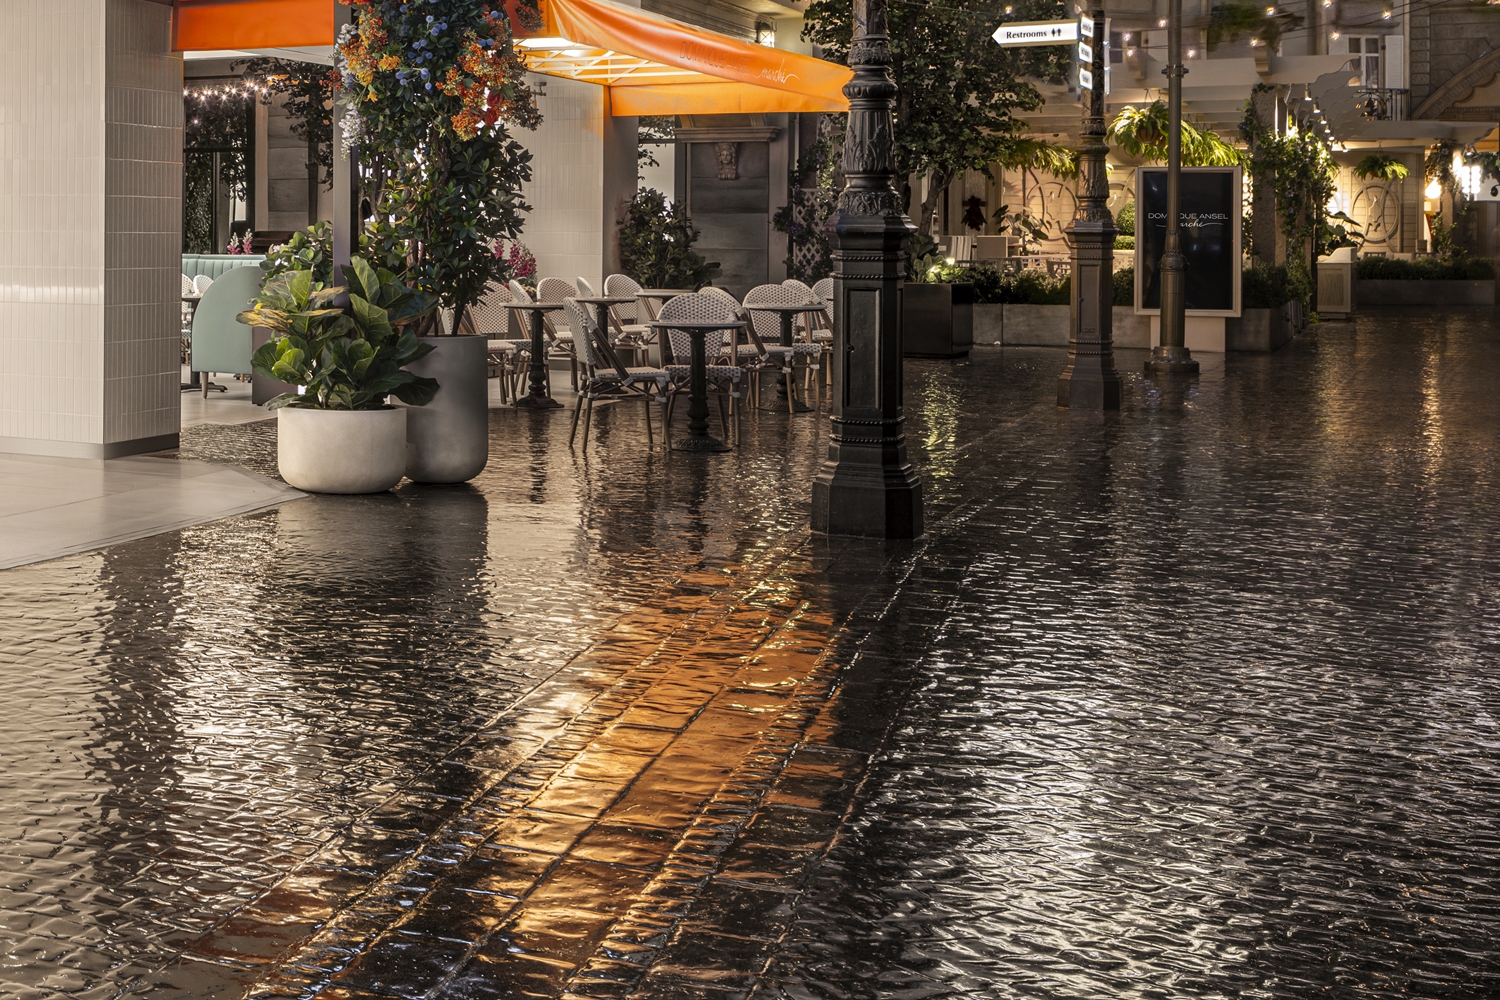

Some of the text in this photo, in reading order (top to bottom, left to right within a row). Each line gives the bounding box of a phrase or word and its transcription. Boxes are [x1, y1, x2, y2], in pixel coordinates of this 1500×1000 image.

[1006, 30, 1047, 39] Restrooms
[1147, 212, 1229, 220] DOMQUE ANSEL
